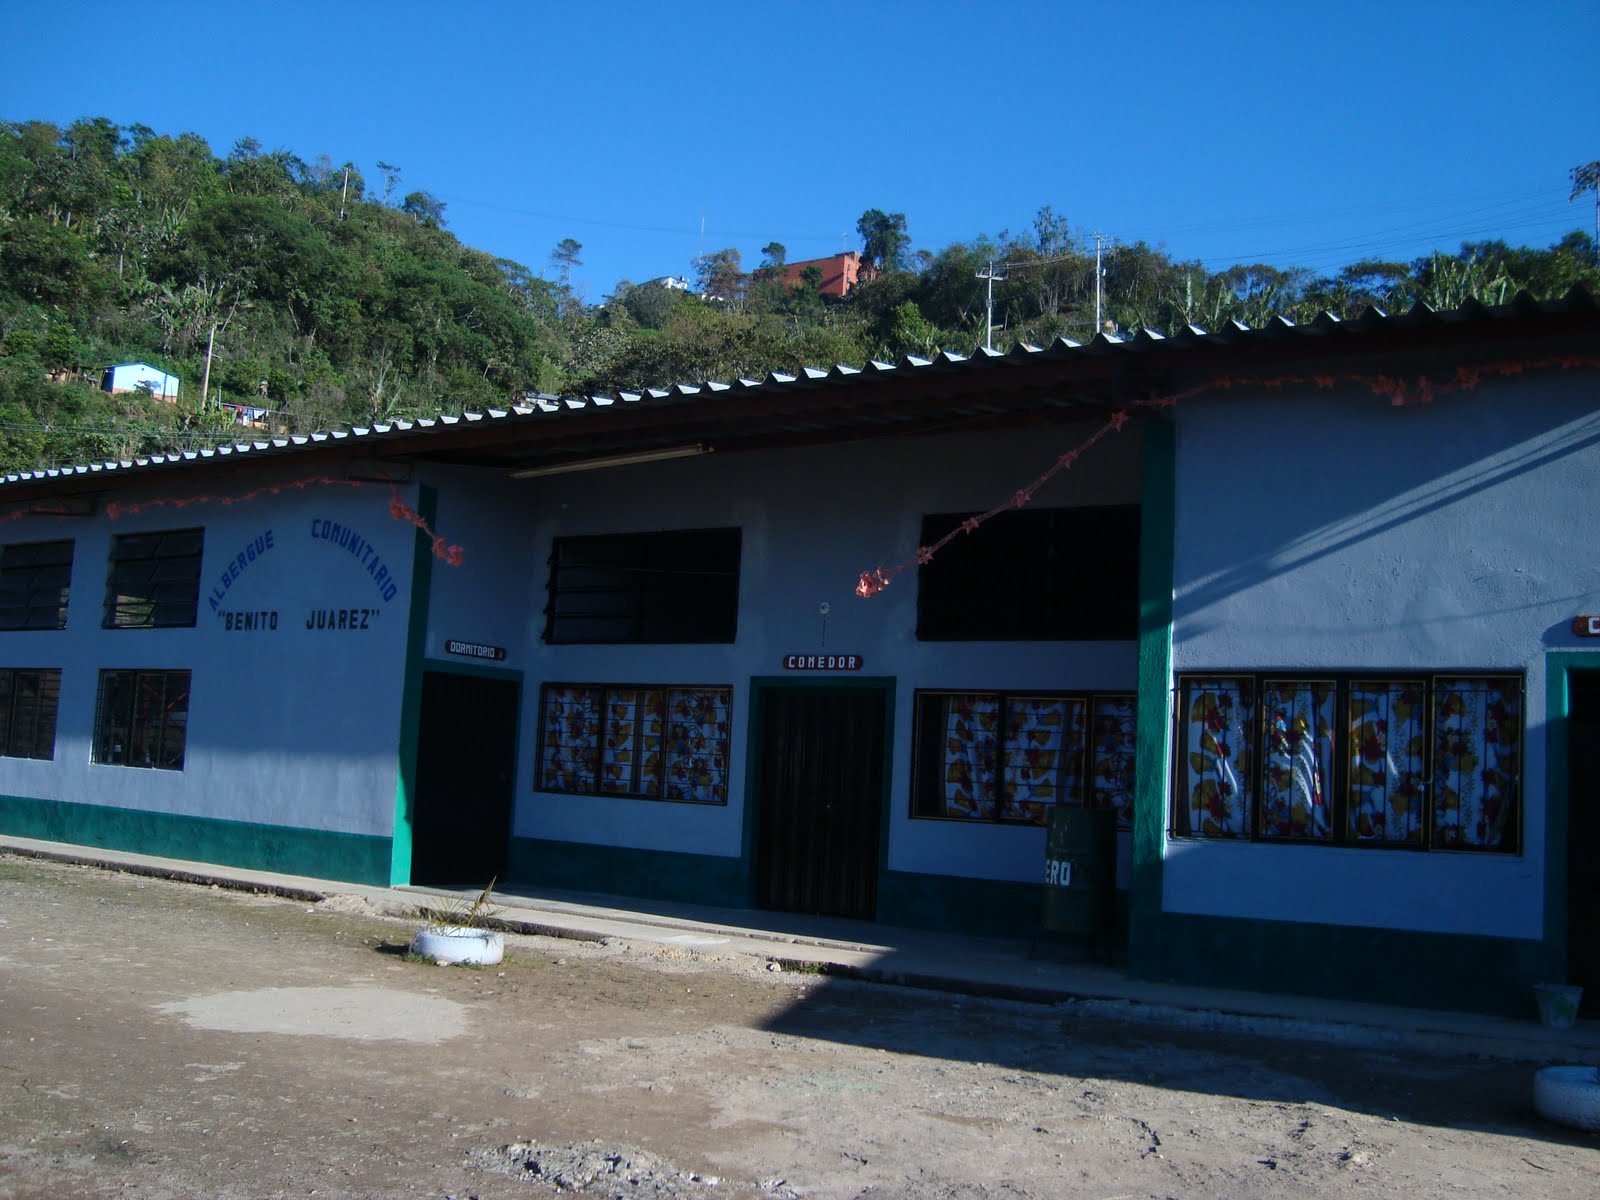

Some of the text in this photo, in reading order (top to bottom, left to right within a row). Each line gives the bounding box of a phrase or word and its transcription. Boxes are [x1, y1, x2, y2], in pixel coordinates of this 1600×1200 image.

[208, 518, 398, 611] ALBERGUE COMUNITARIO
[450, 641, 496, 658] DORMITORIO
[788, 656, 856, 668] COMEDOR
